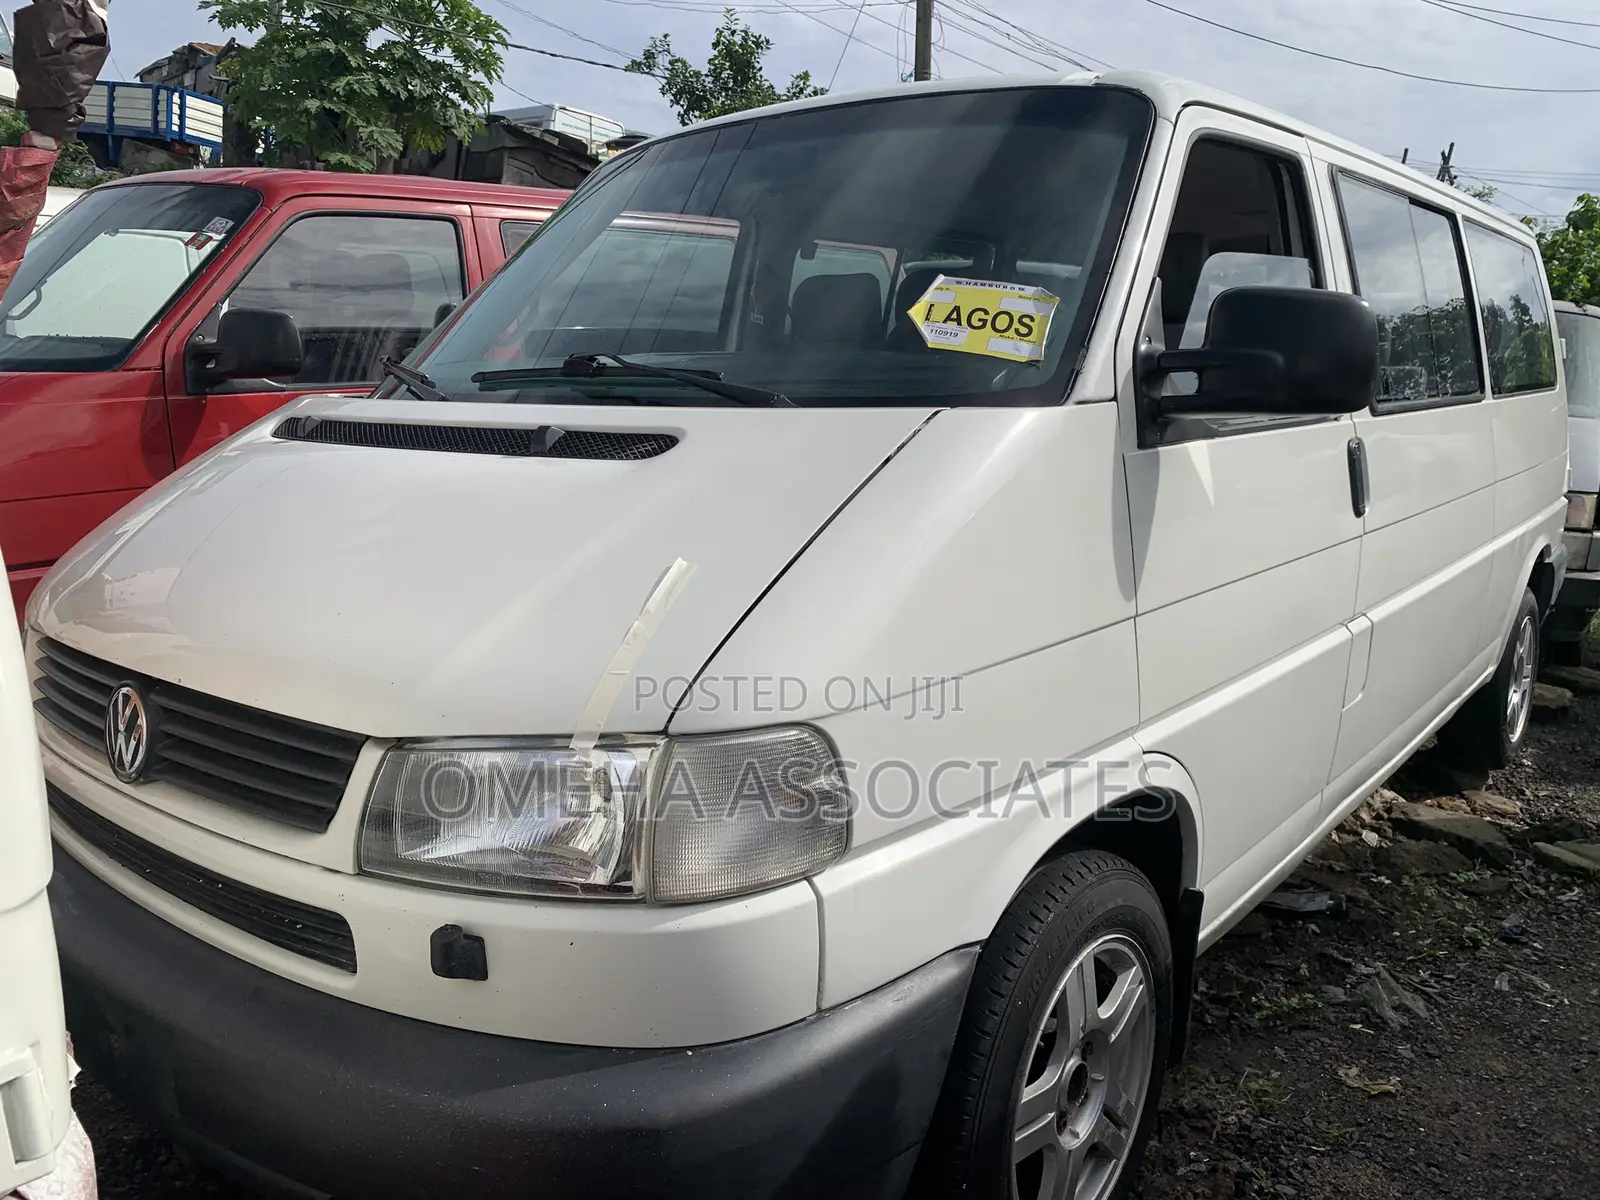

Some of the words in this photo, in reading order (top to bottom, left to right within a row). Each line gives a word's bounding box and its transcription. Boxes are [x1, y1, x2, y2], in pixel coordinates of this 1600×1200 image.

[965, 281, 1015, 291] HAMBURG
[925, 303, 1036, 338] LAGOS
[930, 328, 959, 339] 110919
